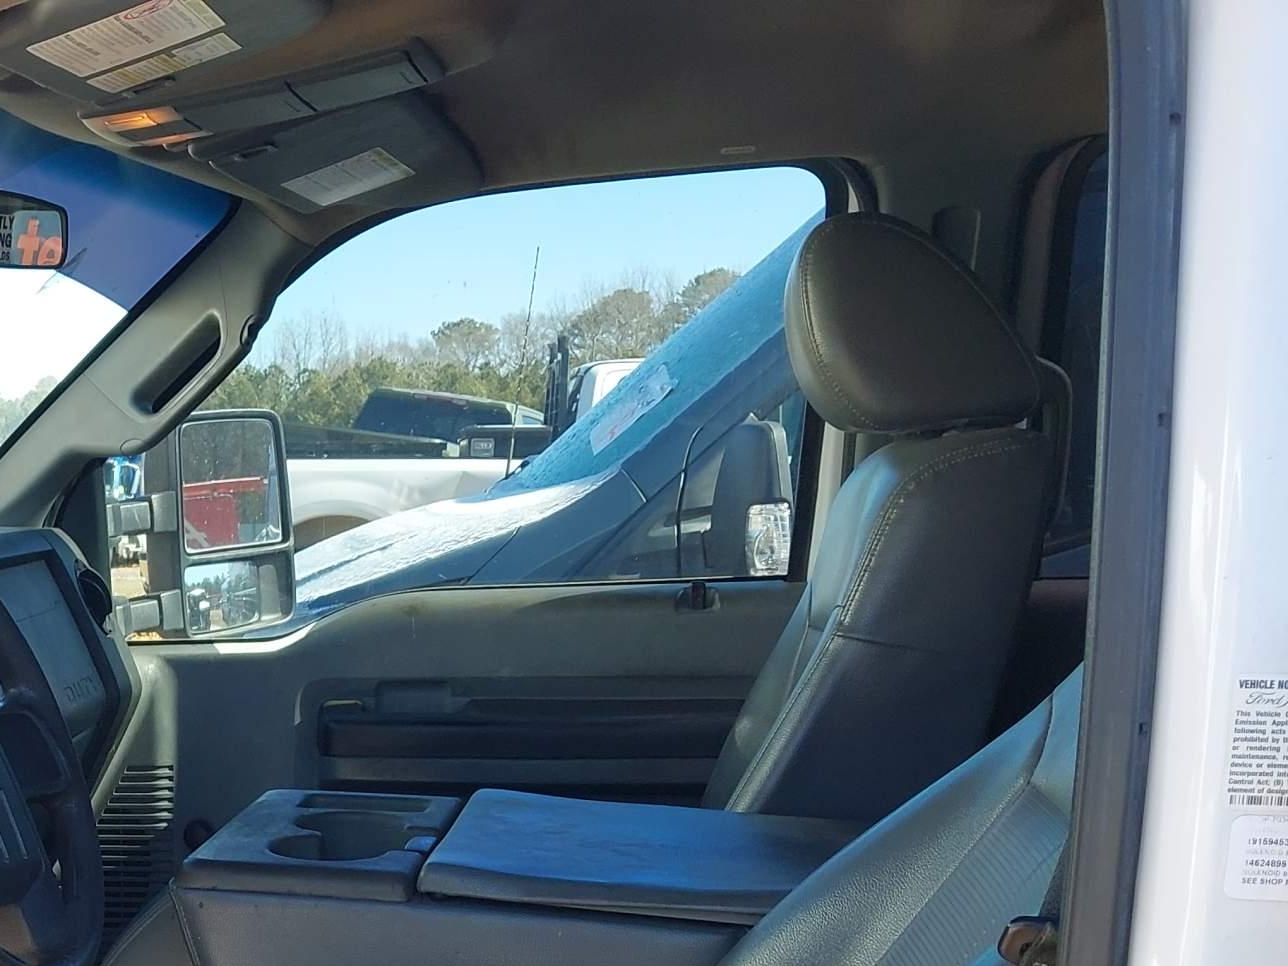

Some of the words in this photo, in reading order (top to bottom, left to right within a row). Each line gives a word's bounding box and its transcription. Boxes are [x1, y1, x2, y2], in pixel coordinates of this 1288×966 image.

[1239, 679, 1276, 689] VEHICLE
[1255, 710, 1282, 718] Vehicle
[1234, 727, 1267, 735] following
[1233, 735, 1269, 743] prohibited
[1271, 736, 1280, 744] by
[1246, 745, 1281, 753] rendering
[1229, 770, 1274, 778] incorporated
